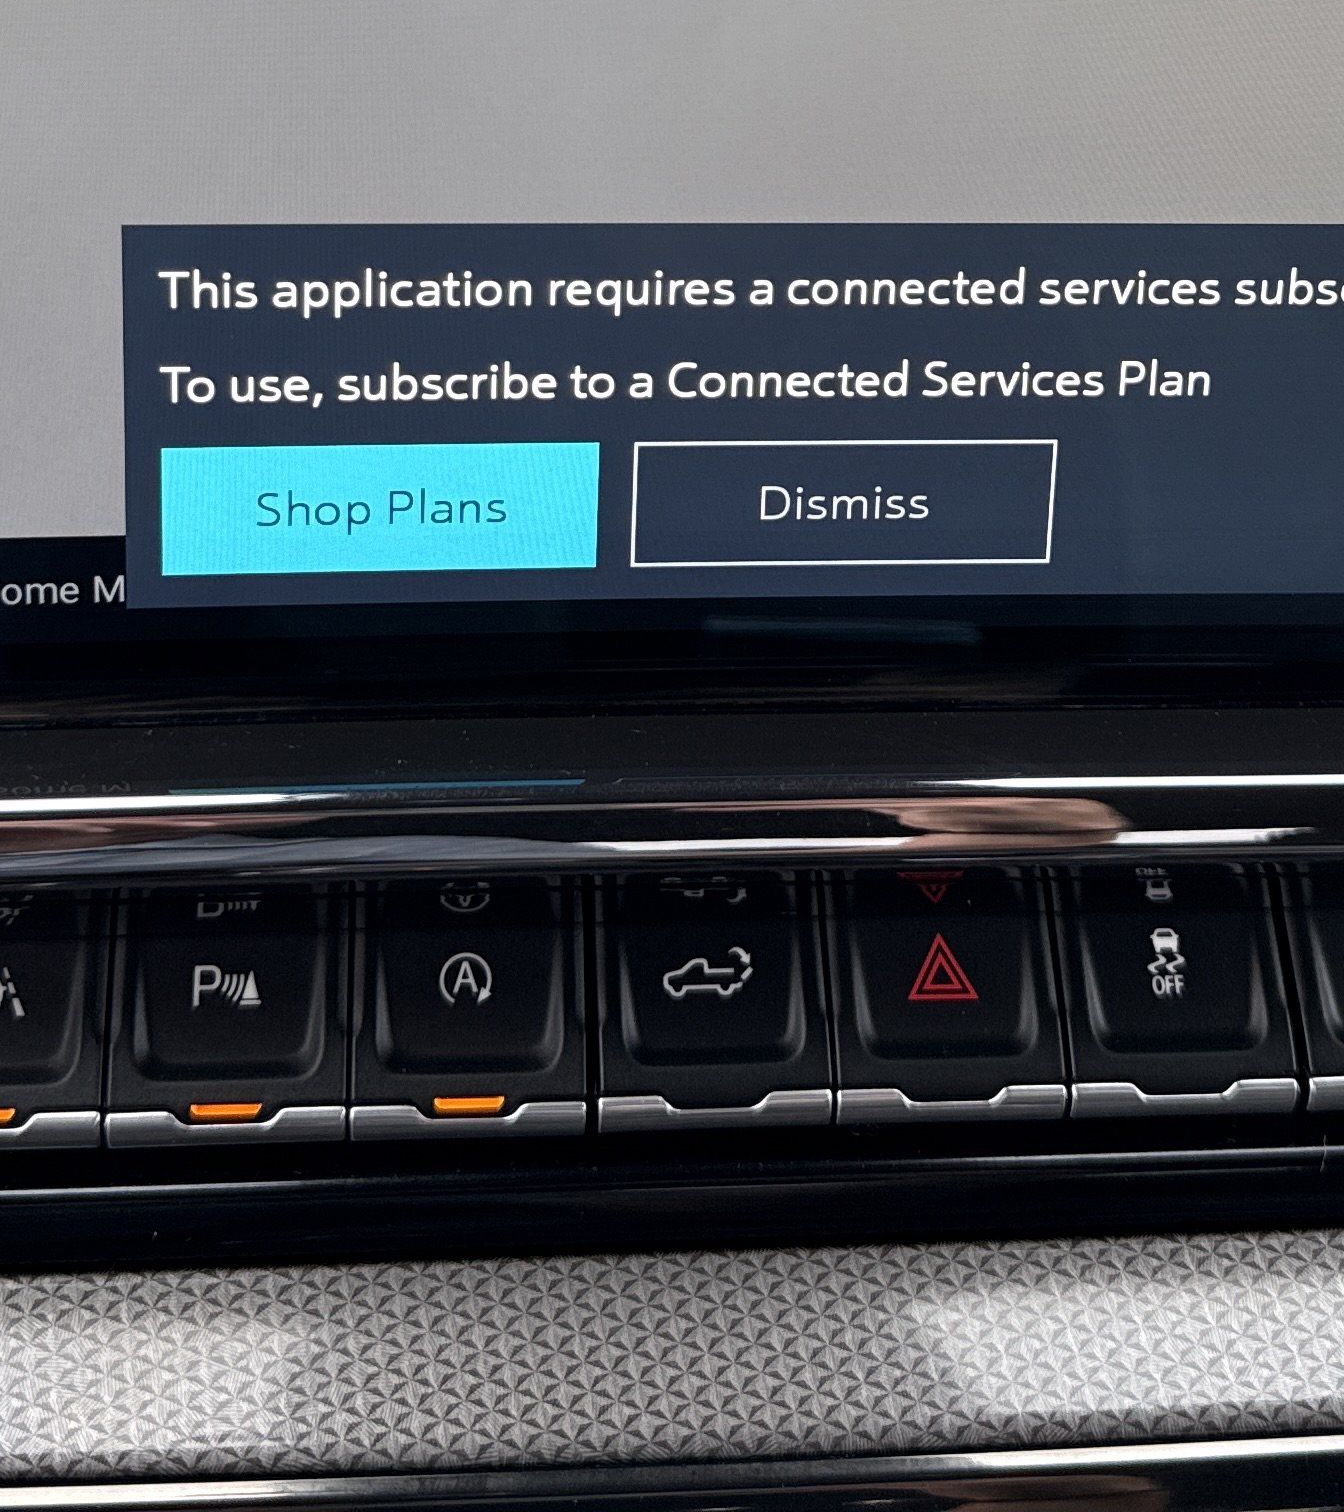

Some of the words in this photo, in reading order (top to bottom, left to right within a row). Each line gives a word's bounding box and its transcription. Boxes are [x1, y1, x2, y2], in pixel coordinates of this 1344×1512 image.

[157, 268, 259, 310] This
[271, 267, 533, 319] application
[548, 269, 736, 317] requires
[748, 279, 774, 306] a
[787, 266, 1026, 306] connected
[1038, 269, 1221, 306] services
[158, 365, 216, 404] To
[230, 375, 324, 409] use,
[337, 360, 558, 402] subscribe
[569, 365, 616, 400] to
[628, 372, 654, 399] a
[667, 358, 909, 399] Connected
[921, 360, 1105, 398] Services
[1118, 358, 1211, 397] Plan
[256, 489, 371, 536] Shop
[388, 487, 507, 525] Plans
[759, 485, 930, 521] Dismiss
[1151, 974, 1184, 996] OFF
